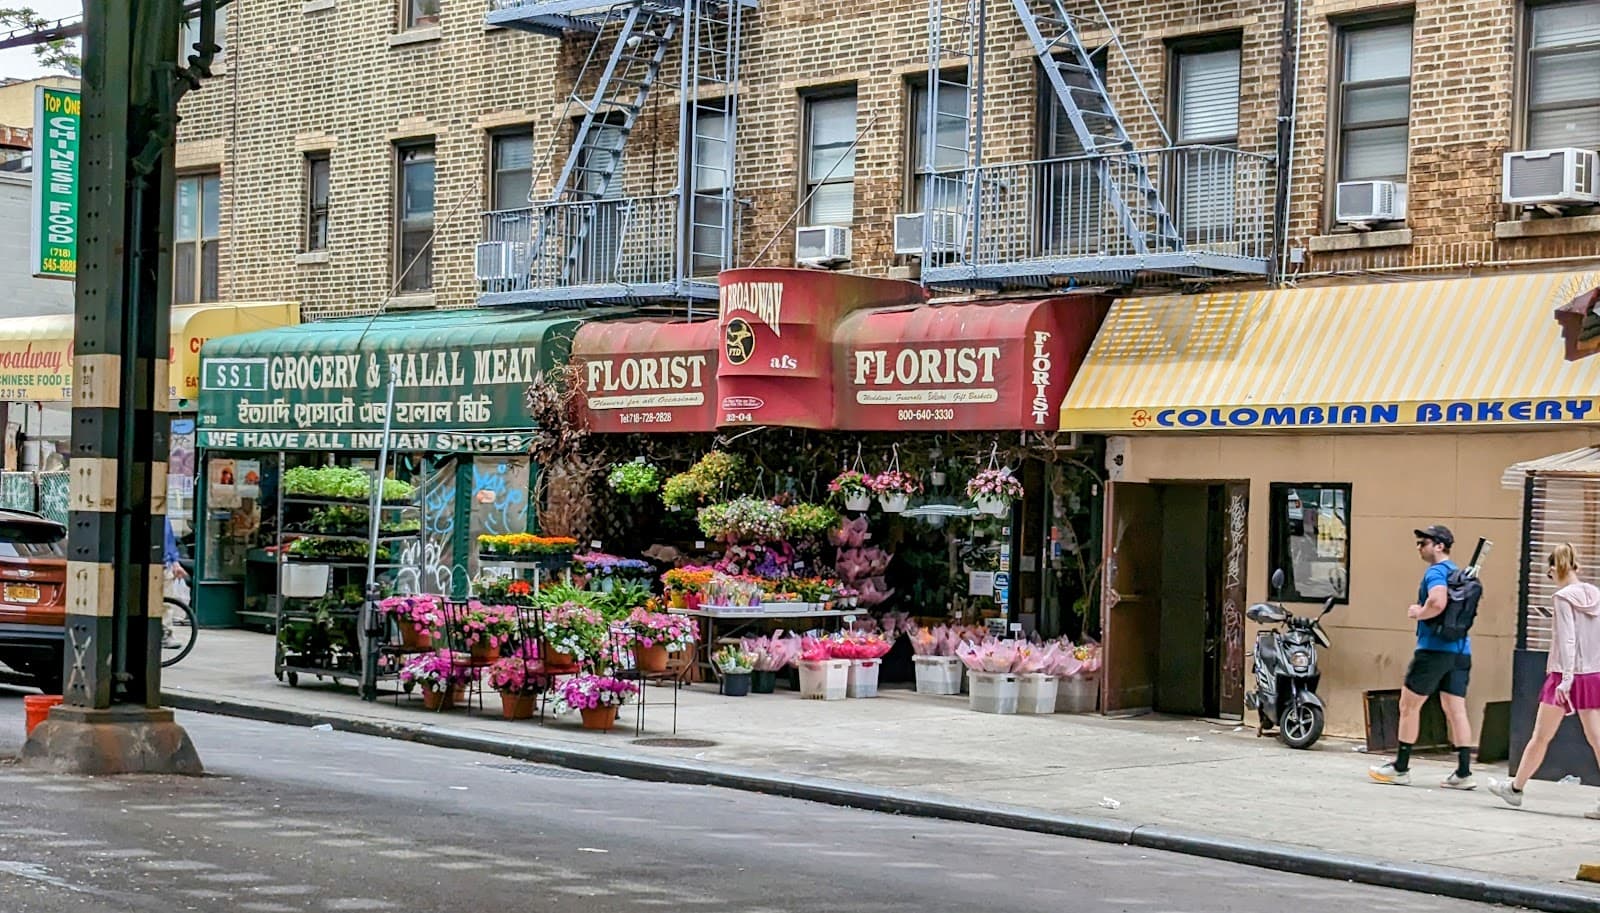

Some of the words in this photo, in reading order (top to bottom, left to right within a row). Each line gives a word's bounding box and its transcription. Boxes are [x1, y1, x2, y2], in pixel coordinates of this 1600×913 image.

[49, 116, 76, 195] CHINESE
[48, 201, 74, 243] FOOD
[50, 247, 71, 258] (718)
[727, 282, 783, 338] BROADWAY
[0, 374, 34, 386] HINESE
[37, 374, 62, 386] FOOD
[186, 377, 199, 387] EA
[271, 354, 361, 390] GROCERY
[366, 352, 381, 388] &
[388, 352, 465, 388] HALAL
[472, 347, 536, 385] MEAT
[587, 355, 706, 392] FLORIST
[854, 347, 1000, 385] FLORIST
[1031, 331, 1052, 424] FLORIST
[898, 408, 954, 421] 800-640-3330
[1156, 404, 1399, 427] COLOMBIAN
[1416, 400, 1593, 422] BAKERY
[207, 432, 238, 447] WE
[243, 432, 299, 448] HAVE
[304, 433, 344, 448] ALL
[351, 433, 429, 449] INDIAN
[436, 434, 522, 451] SPICES
